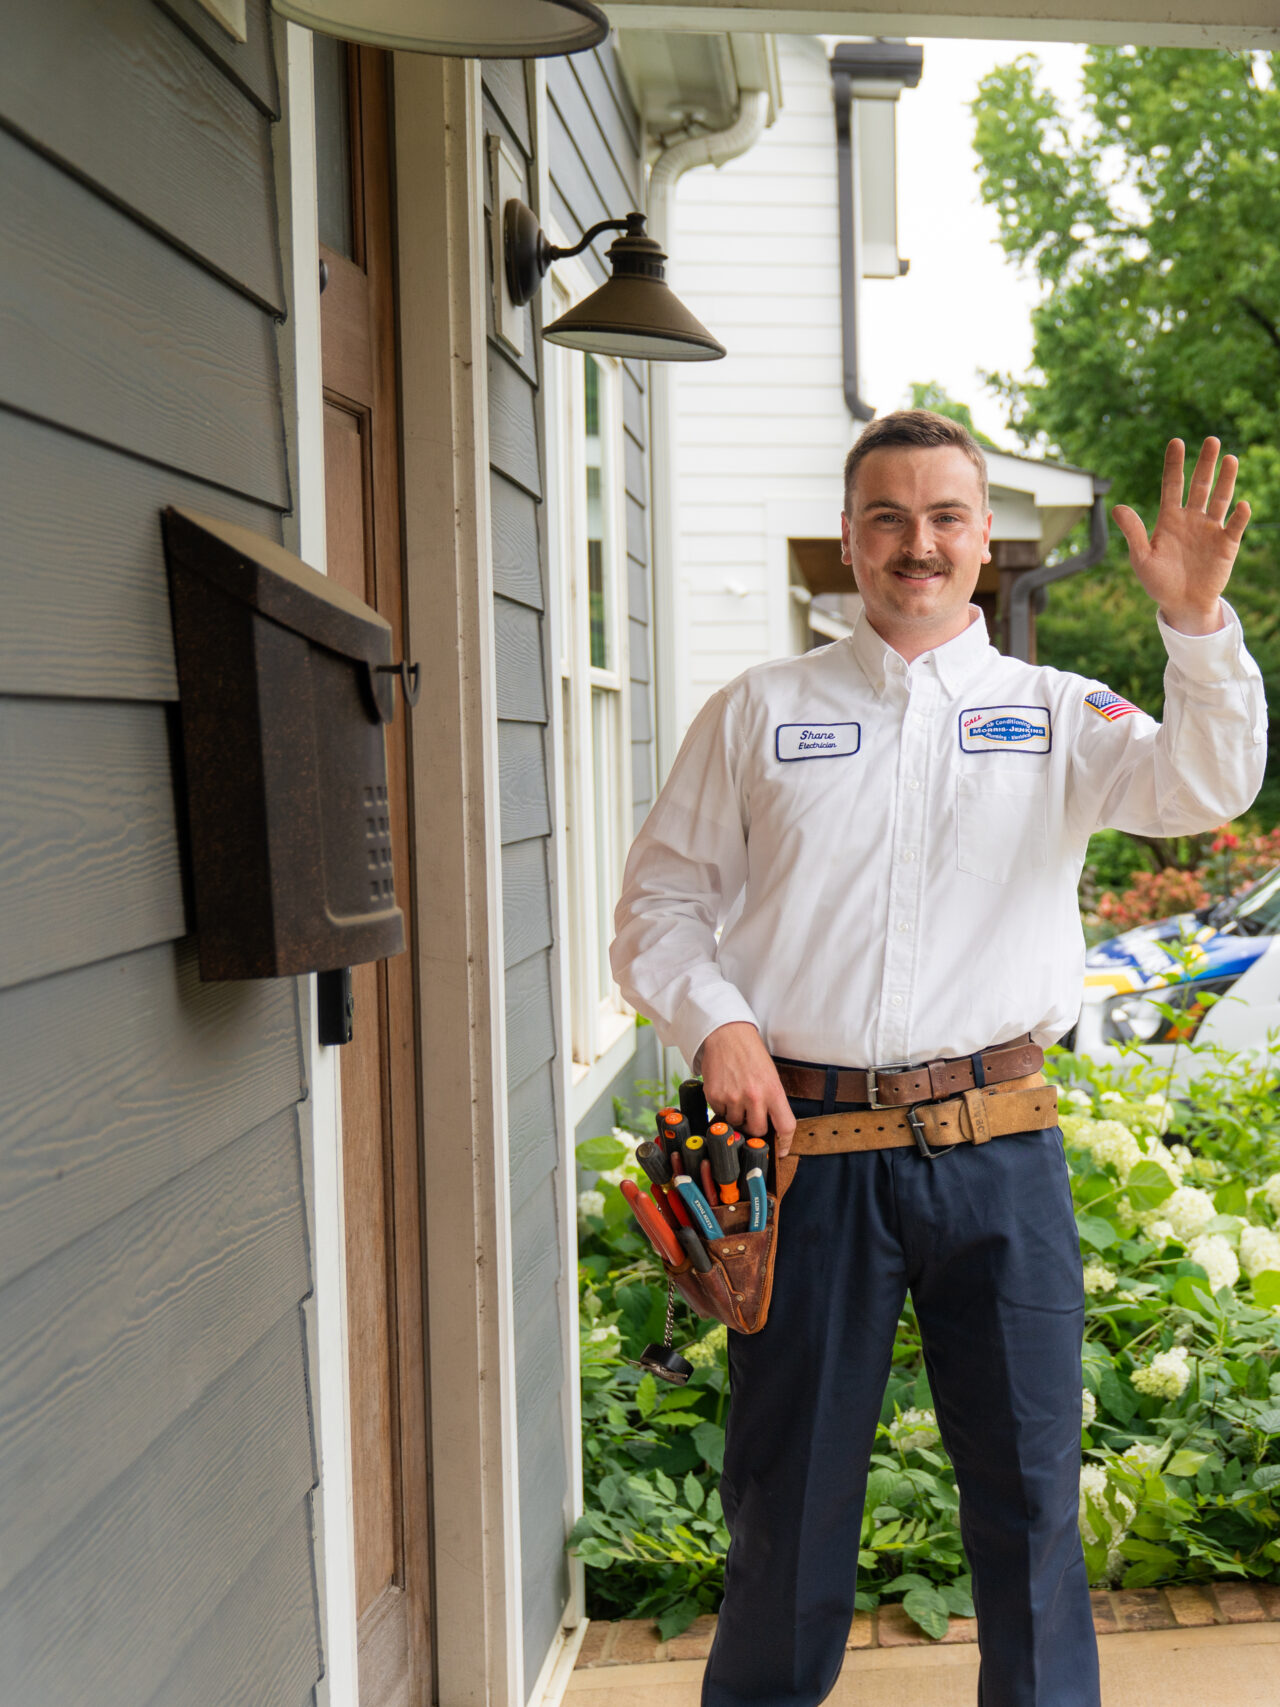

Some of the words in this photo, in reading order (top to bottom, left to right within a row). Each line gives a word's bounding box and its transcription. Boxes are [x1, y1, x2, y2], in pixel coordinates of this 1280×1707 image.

[964, 715, 982, 727] CALL
[995, 719, 1031, 729] Conditioning
[800, 730, 835, 740] Shane
[798, 742, 837, 750] Electrician
